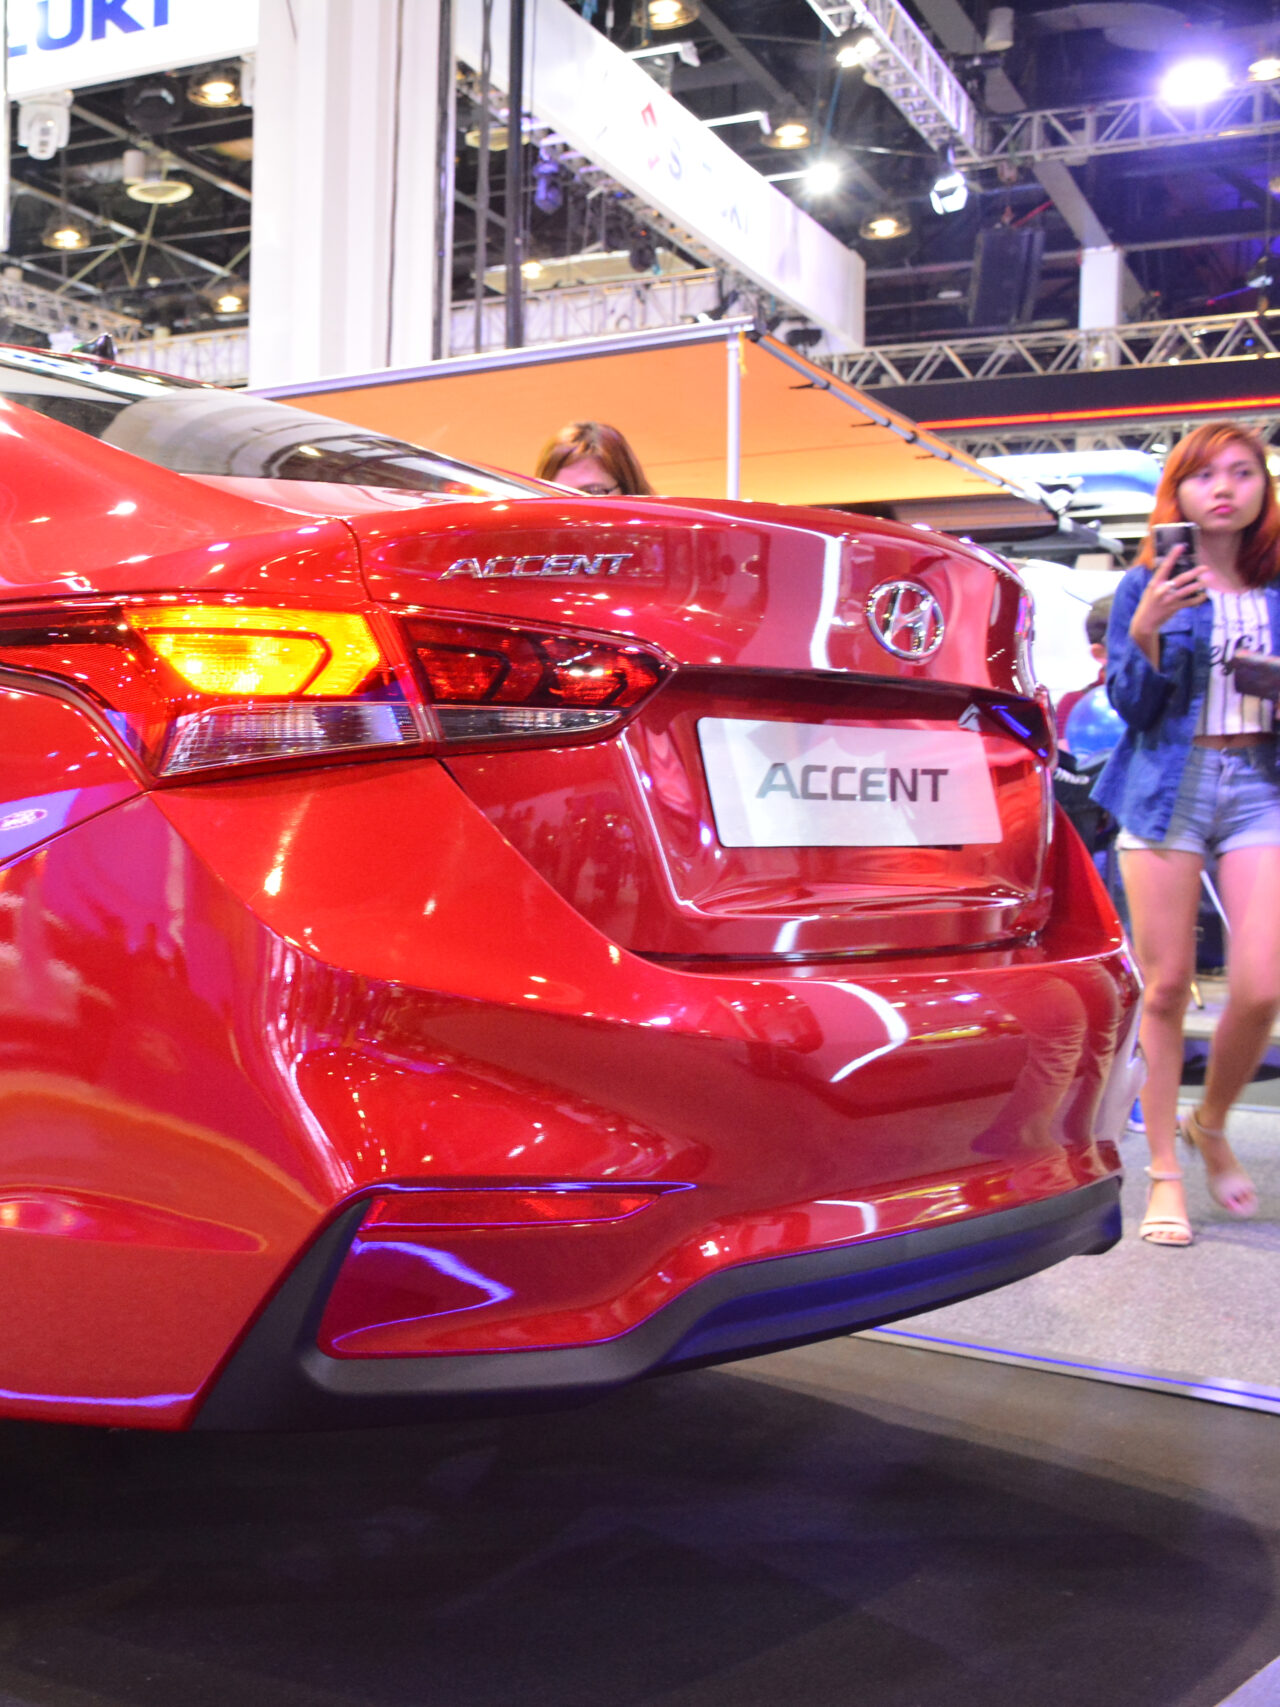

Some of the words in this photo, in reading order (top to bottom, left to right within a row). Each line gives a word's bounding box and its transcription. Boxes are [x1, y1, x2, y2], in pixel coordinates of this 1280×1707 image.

[7, 0, 168, 58] UKI
[437, 553, 634, 581] ACCENT
[755, 762, 949, 803] ACCENT
